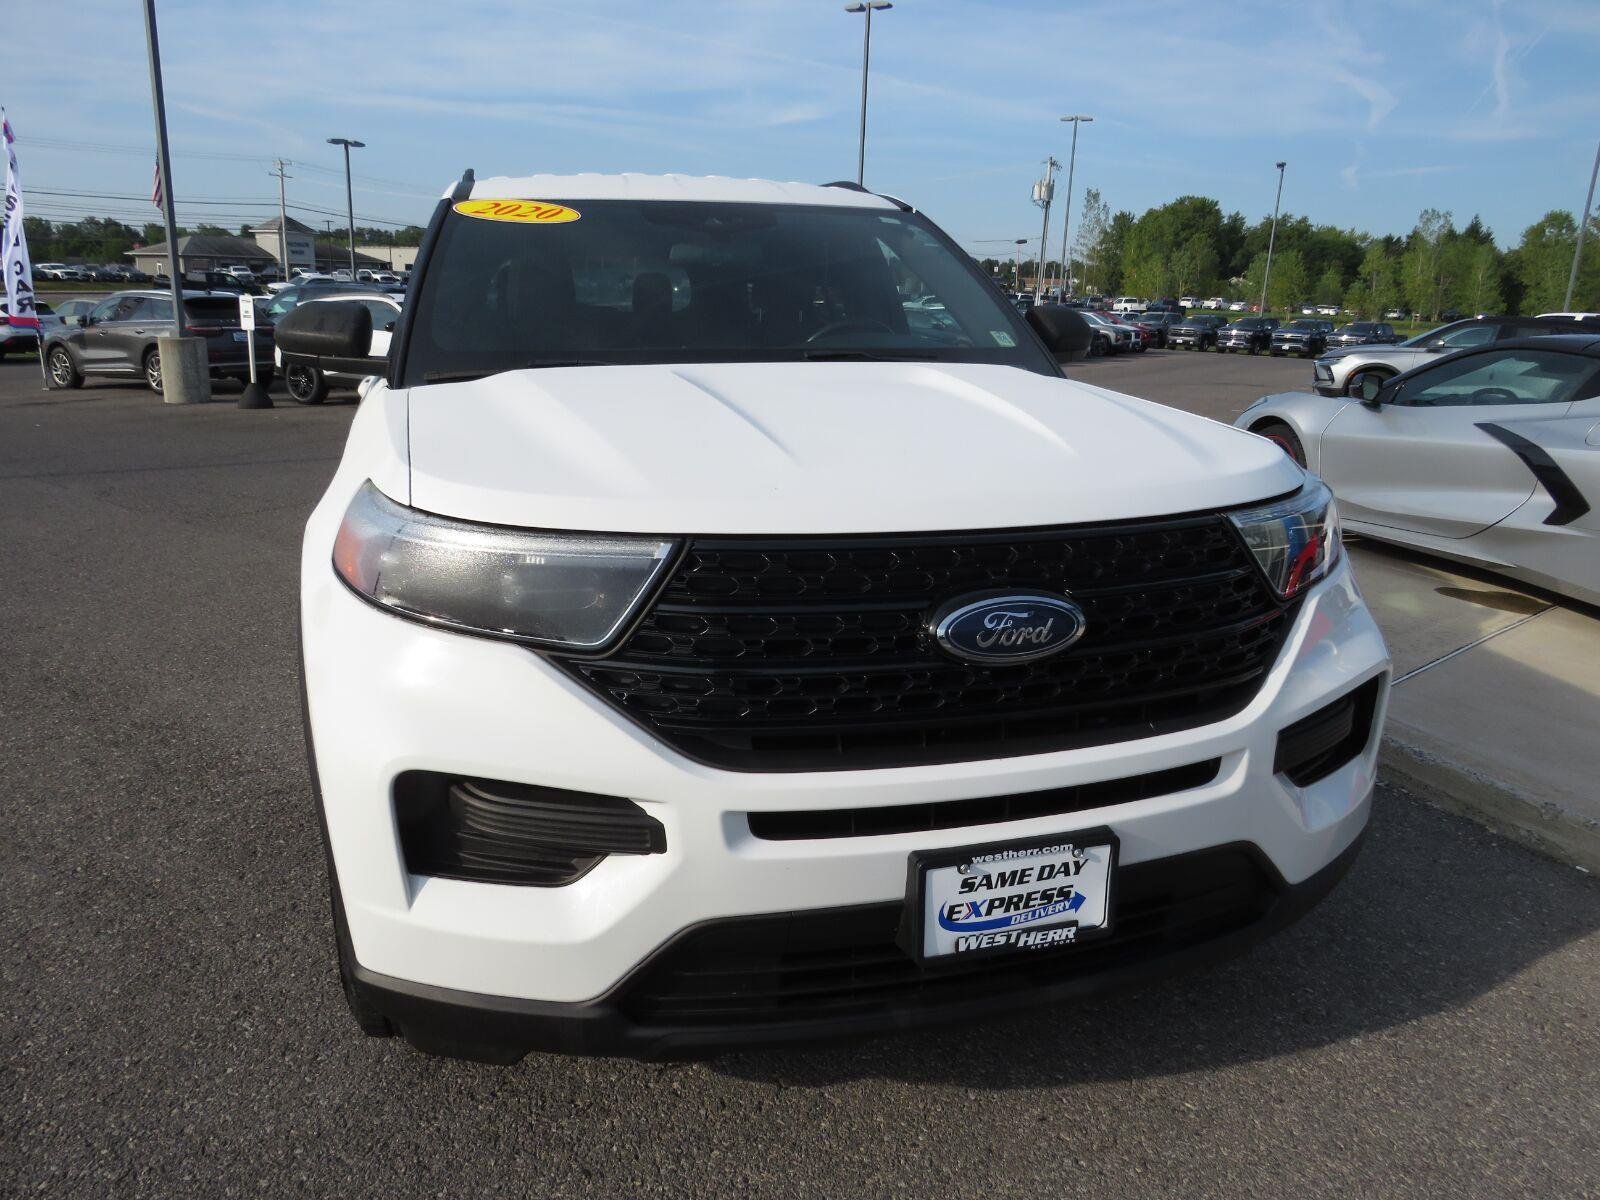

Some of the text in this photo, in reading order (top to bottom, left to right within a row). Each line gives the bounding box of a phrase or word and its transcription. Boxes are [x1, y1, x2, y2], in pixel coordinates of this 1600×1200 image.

[471, 203, 563, 219] 2020
[977, 611, 1054, 648] Ford
[972, 843, 1073, 864] westherr.com
[959, 858, 1088, 895] SAME DAY
[946, 884, 1074, 922] EXPRESS
[1010, 899, 1073, 925] DELIVERY
